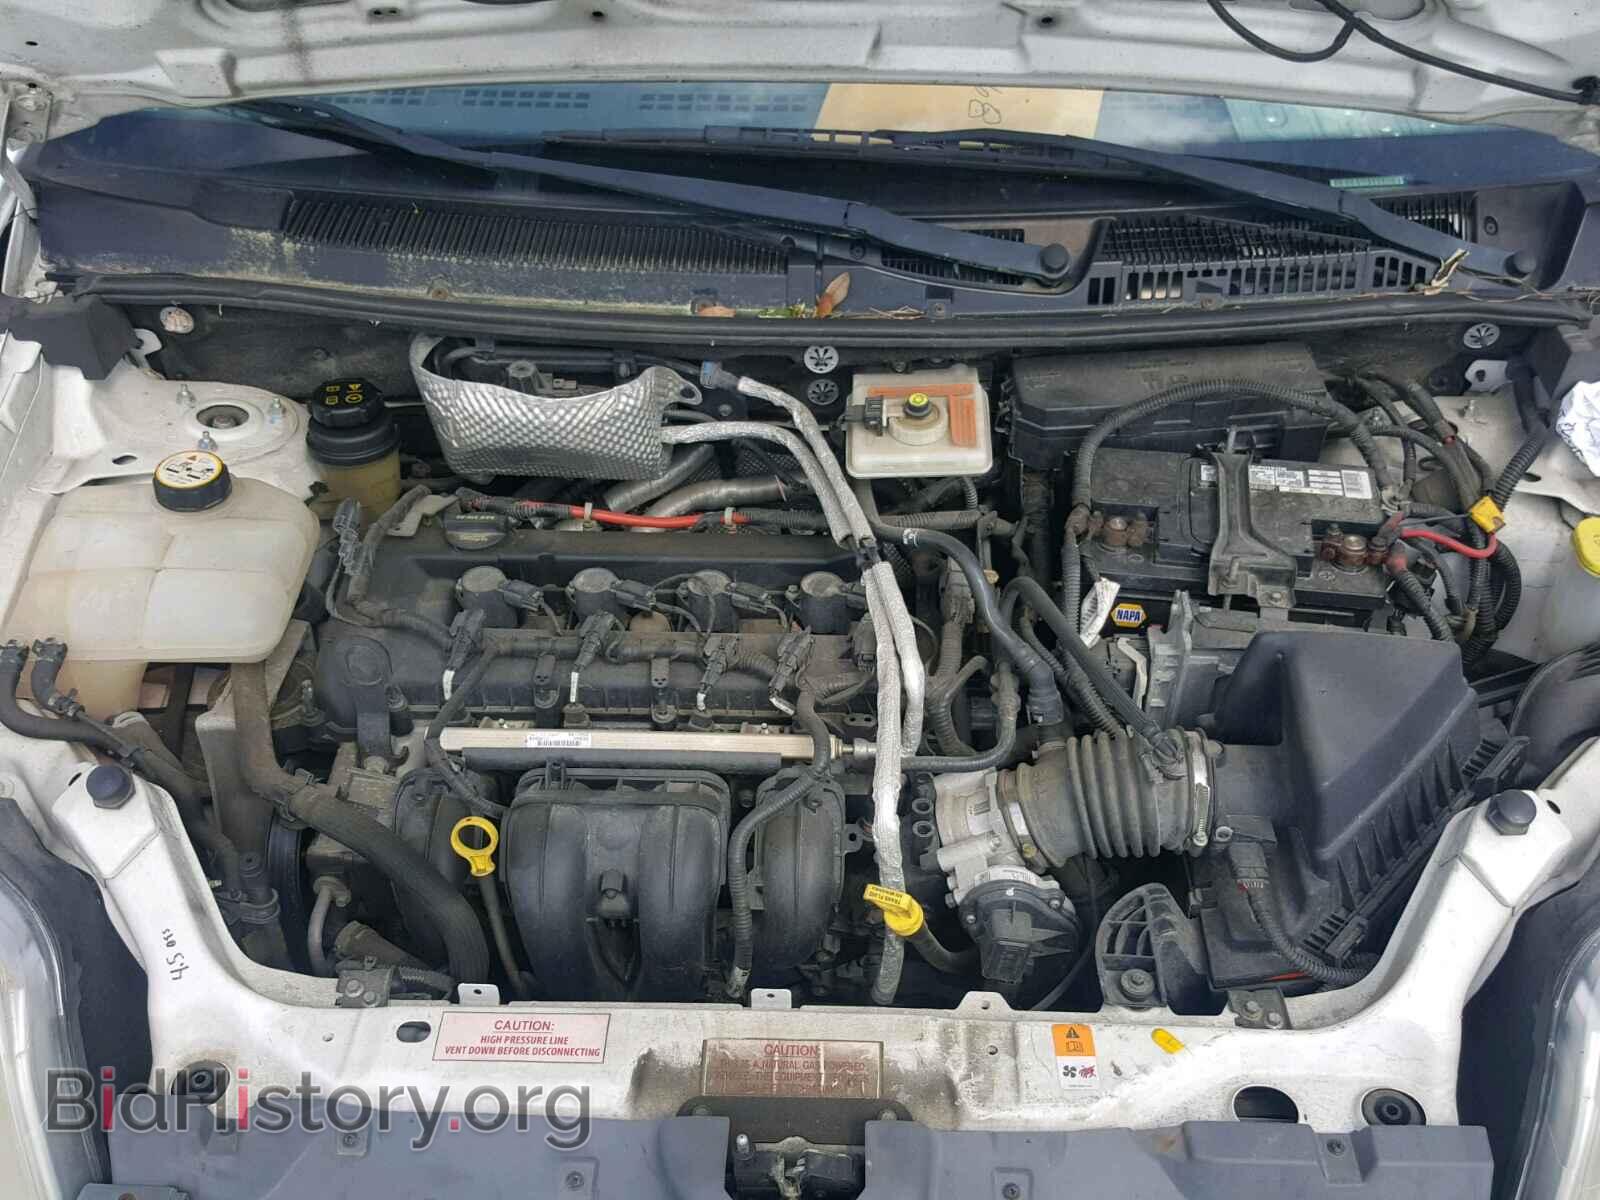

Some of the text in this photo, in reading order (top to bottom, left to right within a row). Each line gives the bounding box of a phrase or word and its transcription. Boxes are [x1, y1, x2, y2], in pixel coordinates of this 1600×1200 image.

[1117, 609, 1140, 621] NAPA
[166, 952, 189, 981] 4.5
[494, 1020, 555, 1031] CAUTION:
[480, 1035, 569, 1045] HIGH PRESSURE LINE
[445, 1046, 601, 1057] VENT DOWN BEFORE DISCONNECTING
